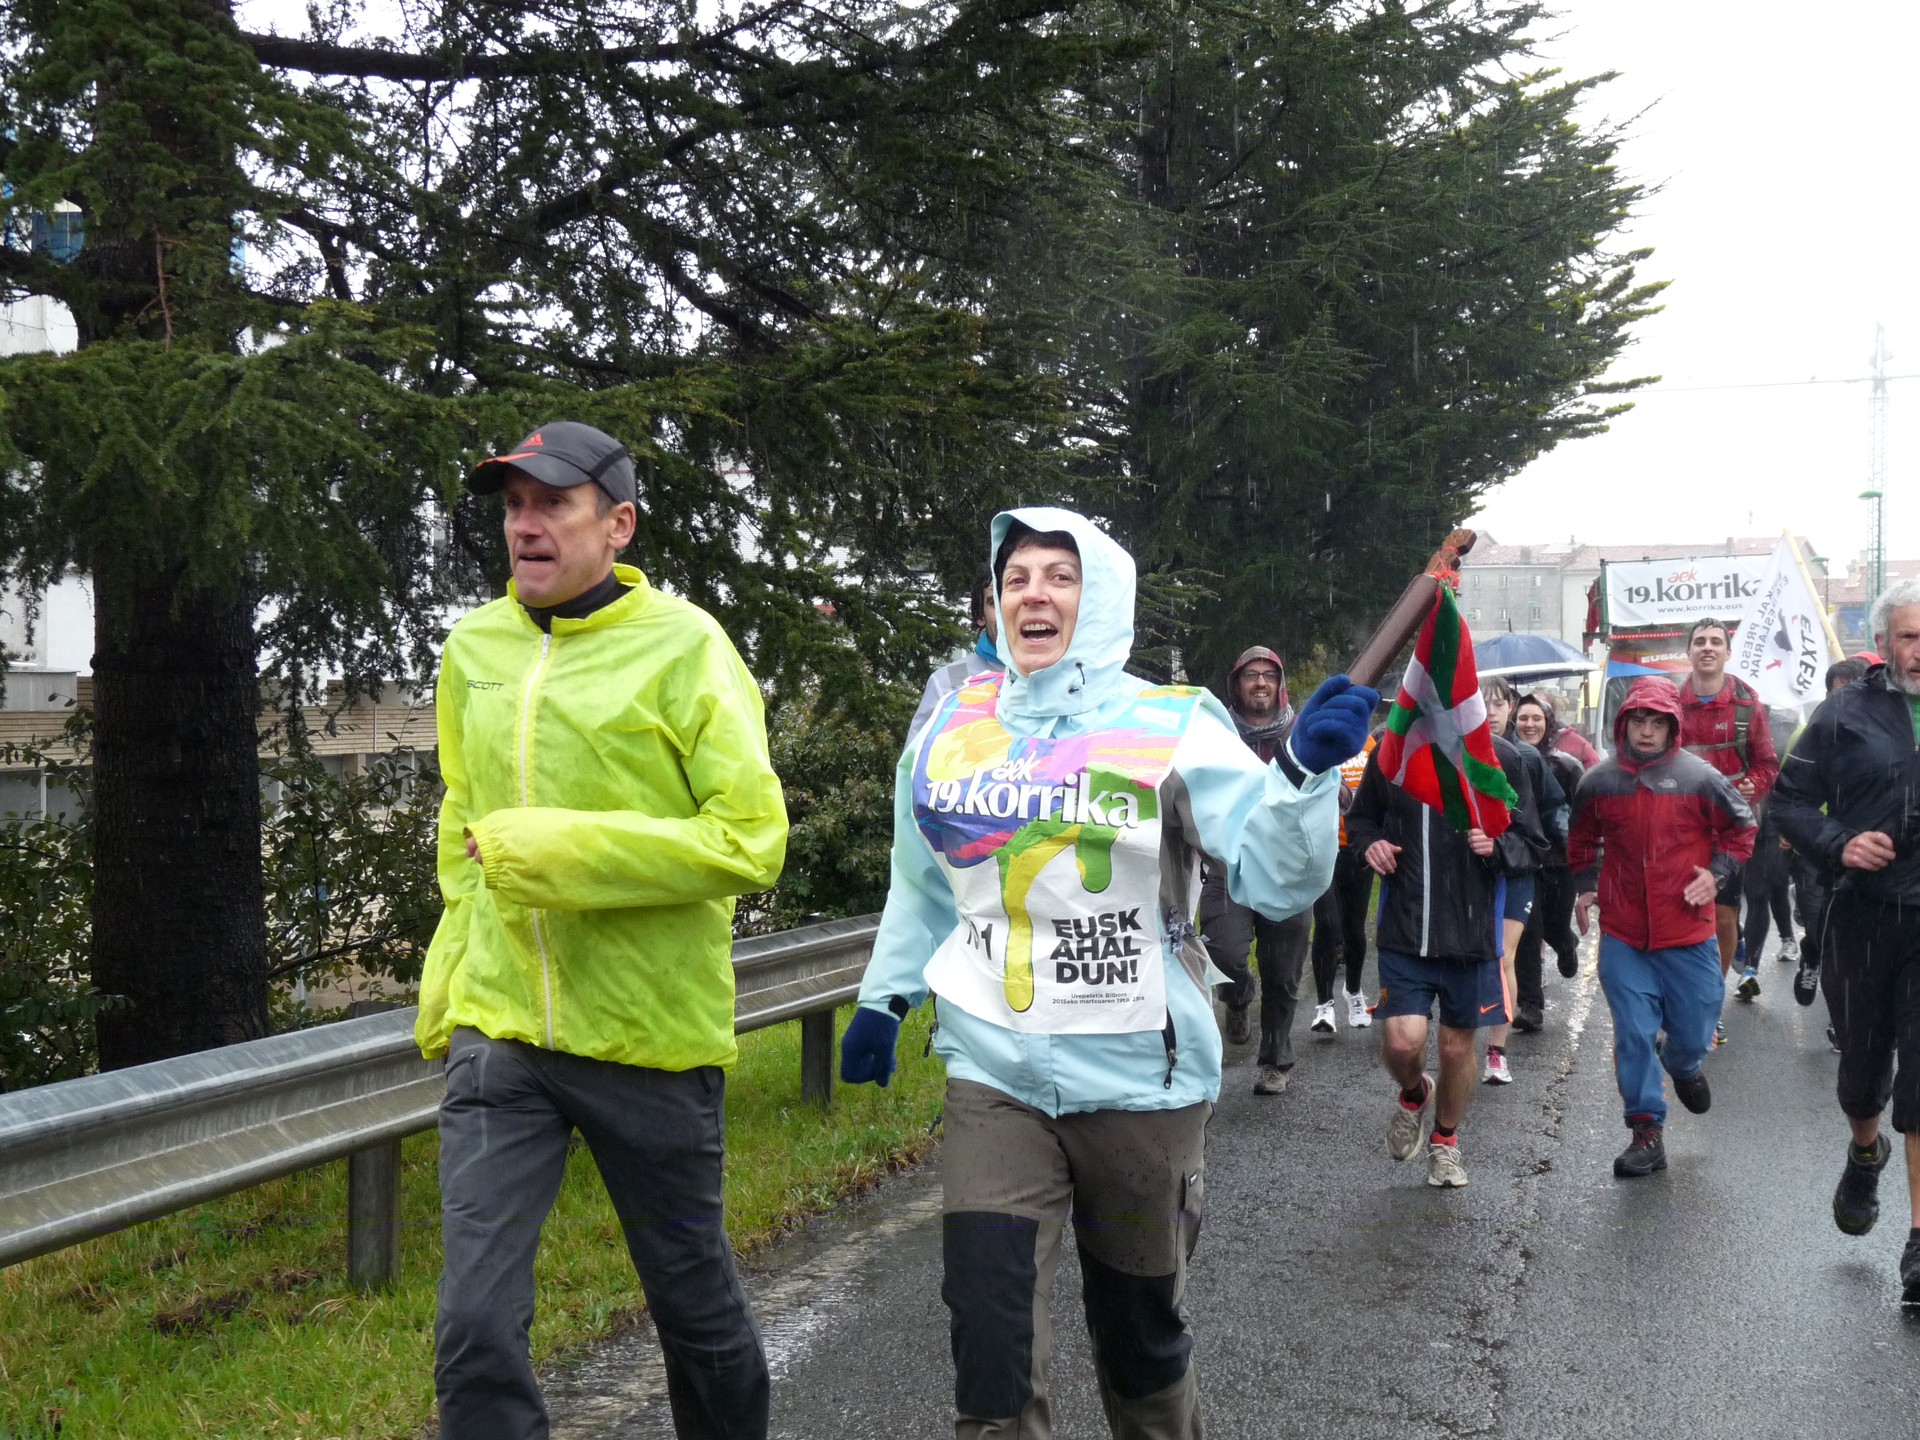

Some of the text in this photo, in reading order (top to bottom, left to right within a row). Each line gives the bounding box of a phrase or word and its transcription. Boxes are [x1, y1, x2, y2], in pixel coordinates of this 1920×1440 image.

[1668, 568, 1698, 583] aek
[1658, 603, 1743, 614] www.korrika.eus
[466, 680, 504, 691] SCOTT
[991, 750, 1040, 783] aek
[926, 768, 1139, 828] 19.korrika
[1051, 907, 1143, 940] EUSK
[1050, 935, 1142, 961] AHAL
[1055, 959, 1139, 986] DUN!
